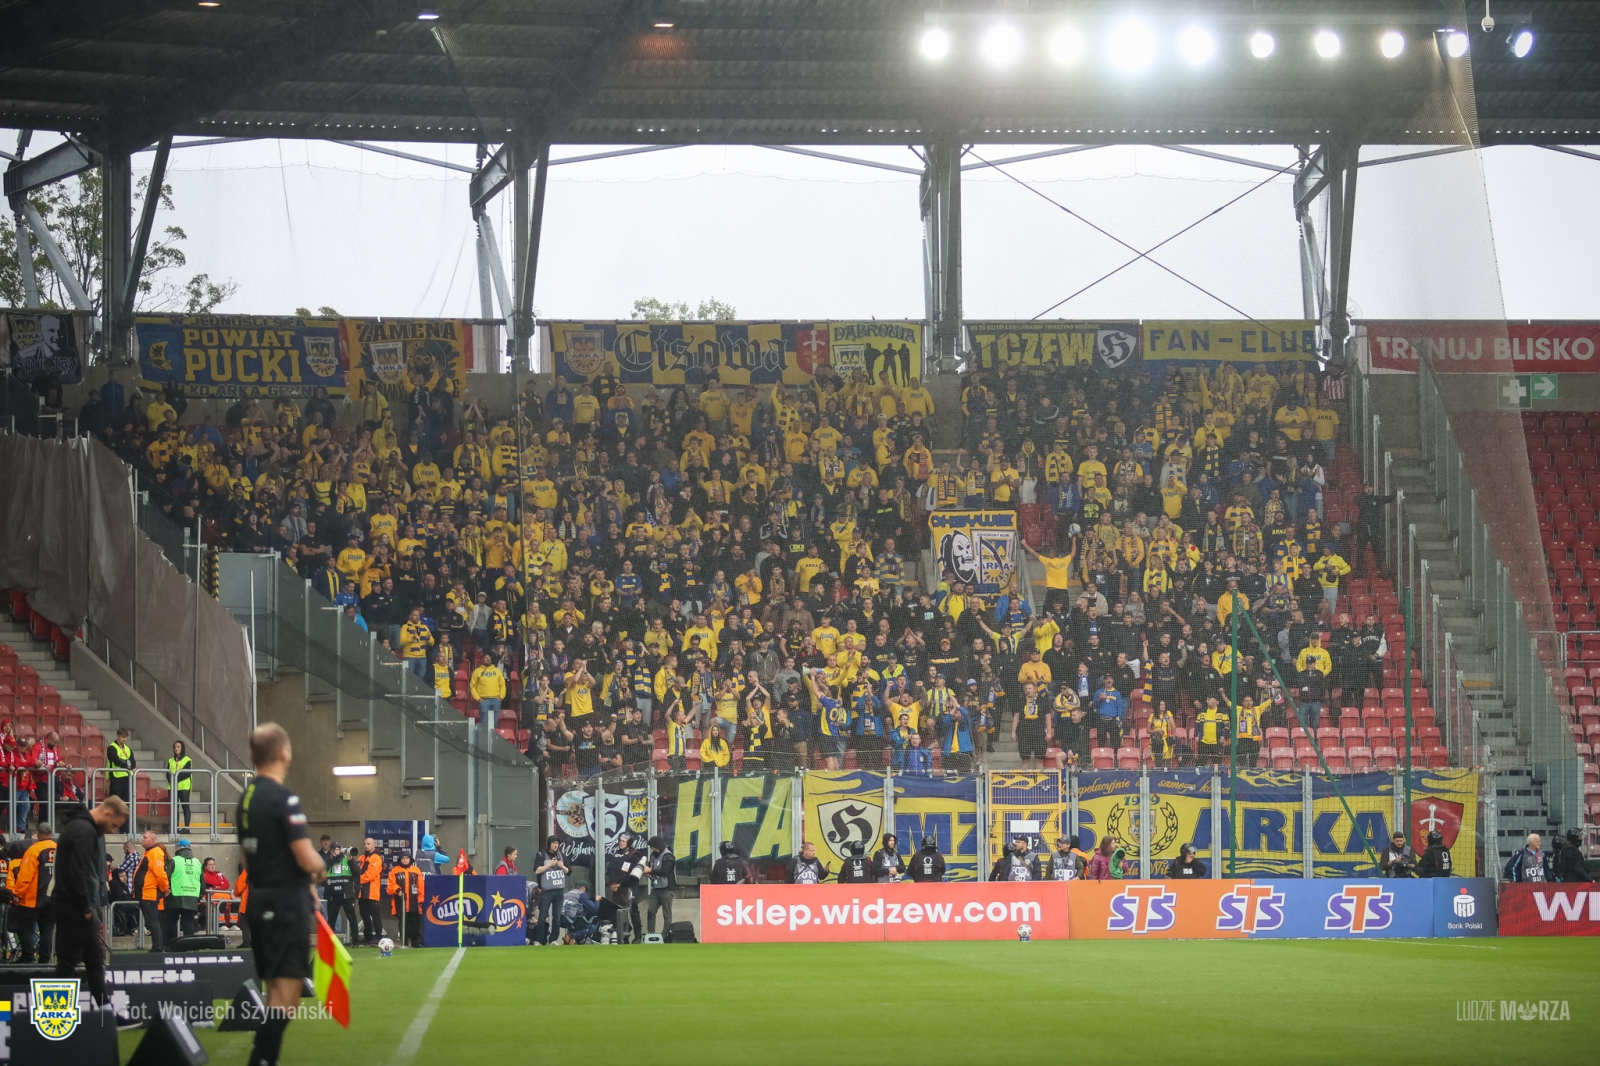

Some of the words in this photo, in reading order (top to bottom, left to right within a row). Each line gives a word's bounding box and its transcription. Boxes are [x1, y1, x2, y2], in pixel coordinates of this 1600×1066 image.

[183, 329, 296, 347] POWIAT
[356, 322, 458, 341] ZAMENA
[1149, 329, 1210, 351] FAN
[1241, 330, 1316, 352] CLUB
[613, 329, 790, 373] Cisowa
[975, 332, 1095, 369] TCZEW
[1376, 337, 1483, 360] TRNUJ
[1494, 337, 1595, 361] BLISKO
[183, 349, 303, 383] PUCKI
[215, 385, 263, 397] ARKA
[1124, 796, 1161, 806] 199
[673, 776, 794, 861] HFA
[895, 809, 1098, 856] MZKS
[1190, 807, 1394, 855] ARKA
[546, 870, 565, 880] FOTO
[496, 905, 519, 925] LOTTO
[716, 898, 1042, 931] sklep.widzew.com
[1107, 885, 1177, 933] STS
[1215, 885, 1285, 933] STS
[1324, 885, 1394, 933] STS
